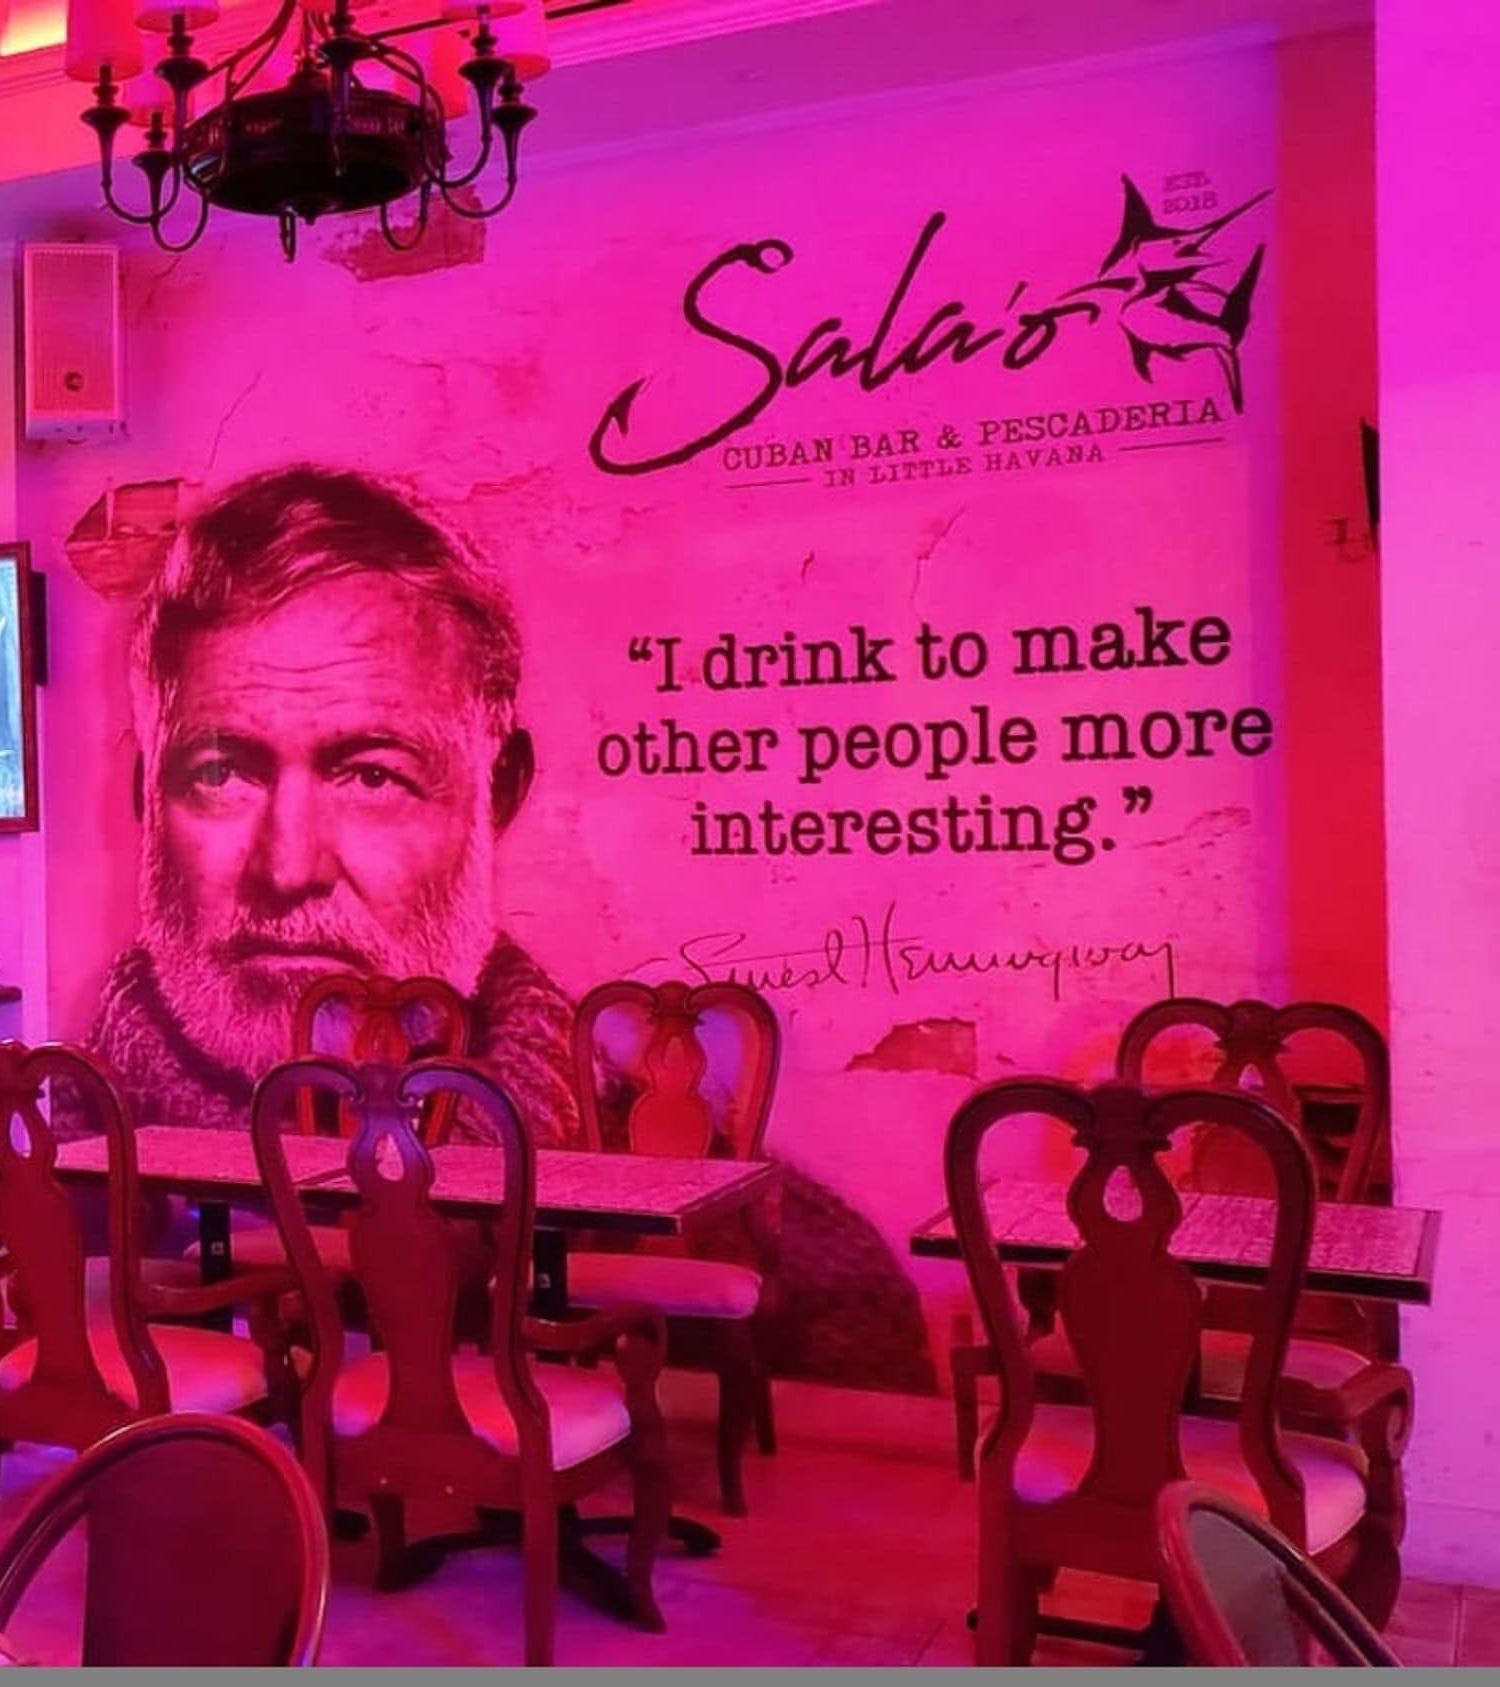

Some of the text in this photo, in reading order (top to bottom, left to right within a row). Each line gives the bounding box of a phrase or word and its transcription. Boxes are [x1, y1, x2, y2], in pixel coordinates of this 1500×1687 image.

[1162, 191, 1219, 215] 2018
[722, 396, 1224, 472] CUBAN BAR & PESCADERIA
[823, 444, 1106, 489] IN LITTLE HAVANA
[701, 626, 897, 691] drink
[916, 620, 989, 681] to
[1013, 606, 1232, 677] make
[598, 704, 1275, 785] other people more
